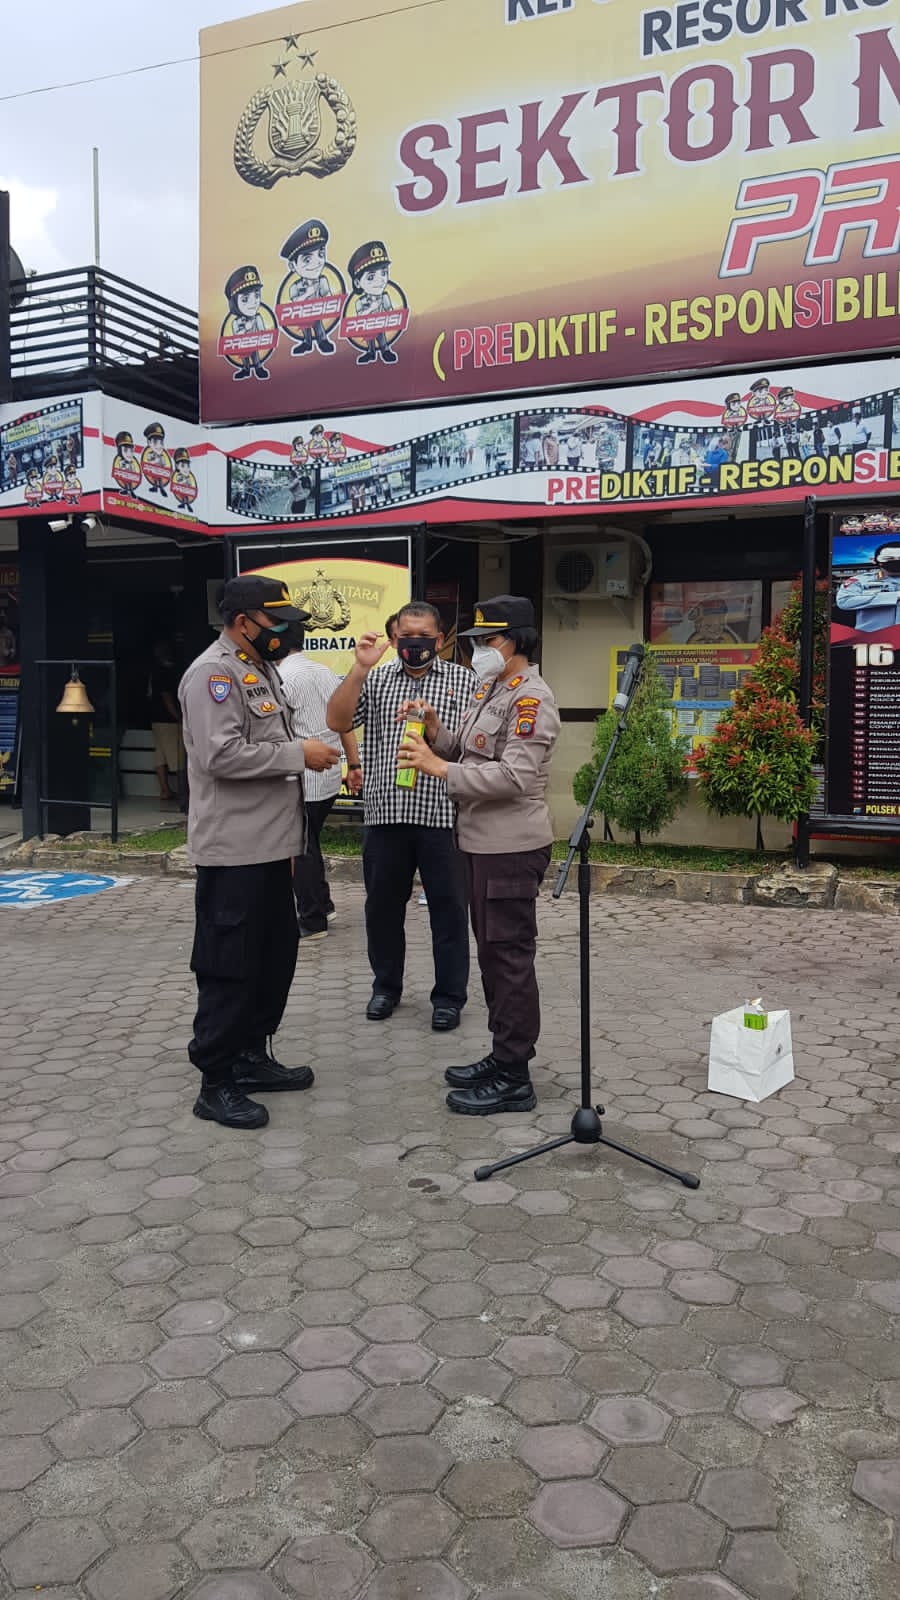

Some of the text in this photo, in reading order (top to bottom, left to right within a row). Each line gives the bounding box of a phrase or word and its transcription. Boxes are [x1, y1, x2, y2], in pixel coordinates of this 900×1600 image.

[643, 0, 808, 56] RESOR
[395, 48, 819, 213] SEKTOR
[281, 301, 341, 321] PRESISI
[453, 310, 617, 371] PREDIKTIF
[644, 272, 900, 346] RESPONSIBIL
[346, 315, 403, 333] PRESISI
[223, 334, 273, 352] PRESISI
[547, 467, 695, 504] PREDIKTIF
[303, 637, 356, 651] IBRATA
[852, 643, 895, 667] 16
[865, 804, 896, 815] POLSEK
